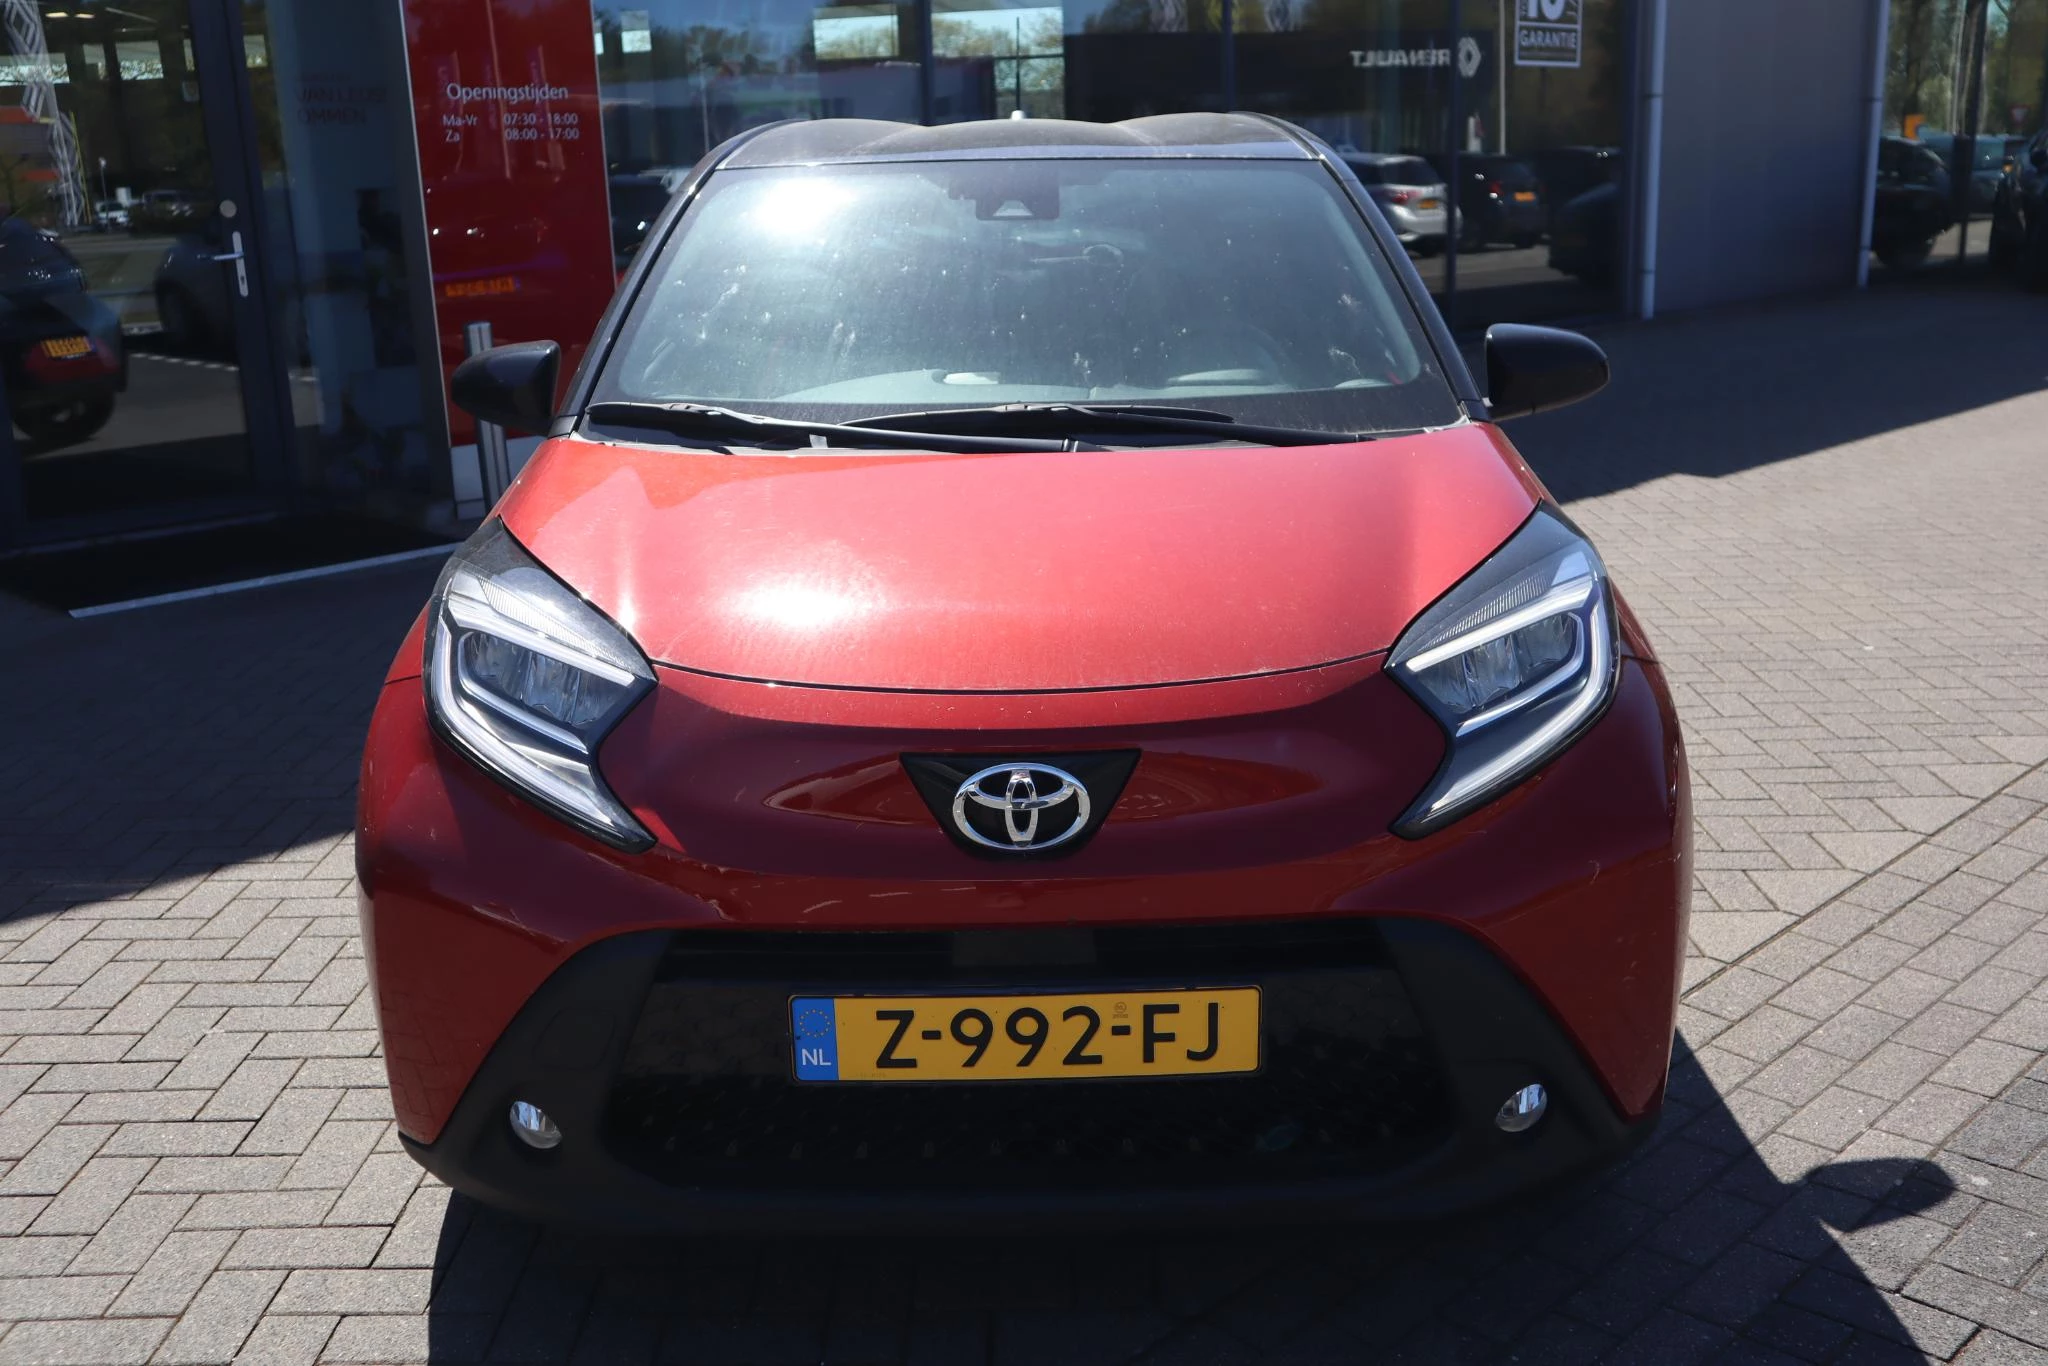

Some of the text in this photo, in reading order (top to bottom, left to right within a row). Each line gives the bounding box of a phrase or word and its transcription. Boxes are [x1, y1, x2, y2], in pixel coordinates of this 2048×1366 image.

[1519, 30, 1577, 48] GARANTIE
[446, 82, 569, 104] Openingstijden
[442, 113, 478, 126] Ma-Vr
[503, 112, 537, 125] 07:30
[547, 112, 579, 125] 18:00
[445, 129, 460, 142] Za
[504, 127, 538, 140] 08:00
[549, 127, 580, 140] 17:00
[875, 1002, 1220, 1069] Z-992-FJ
[801, 1048, 831, 1066] NL
